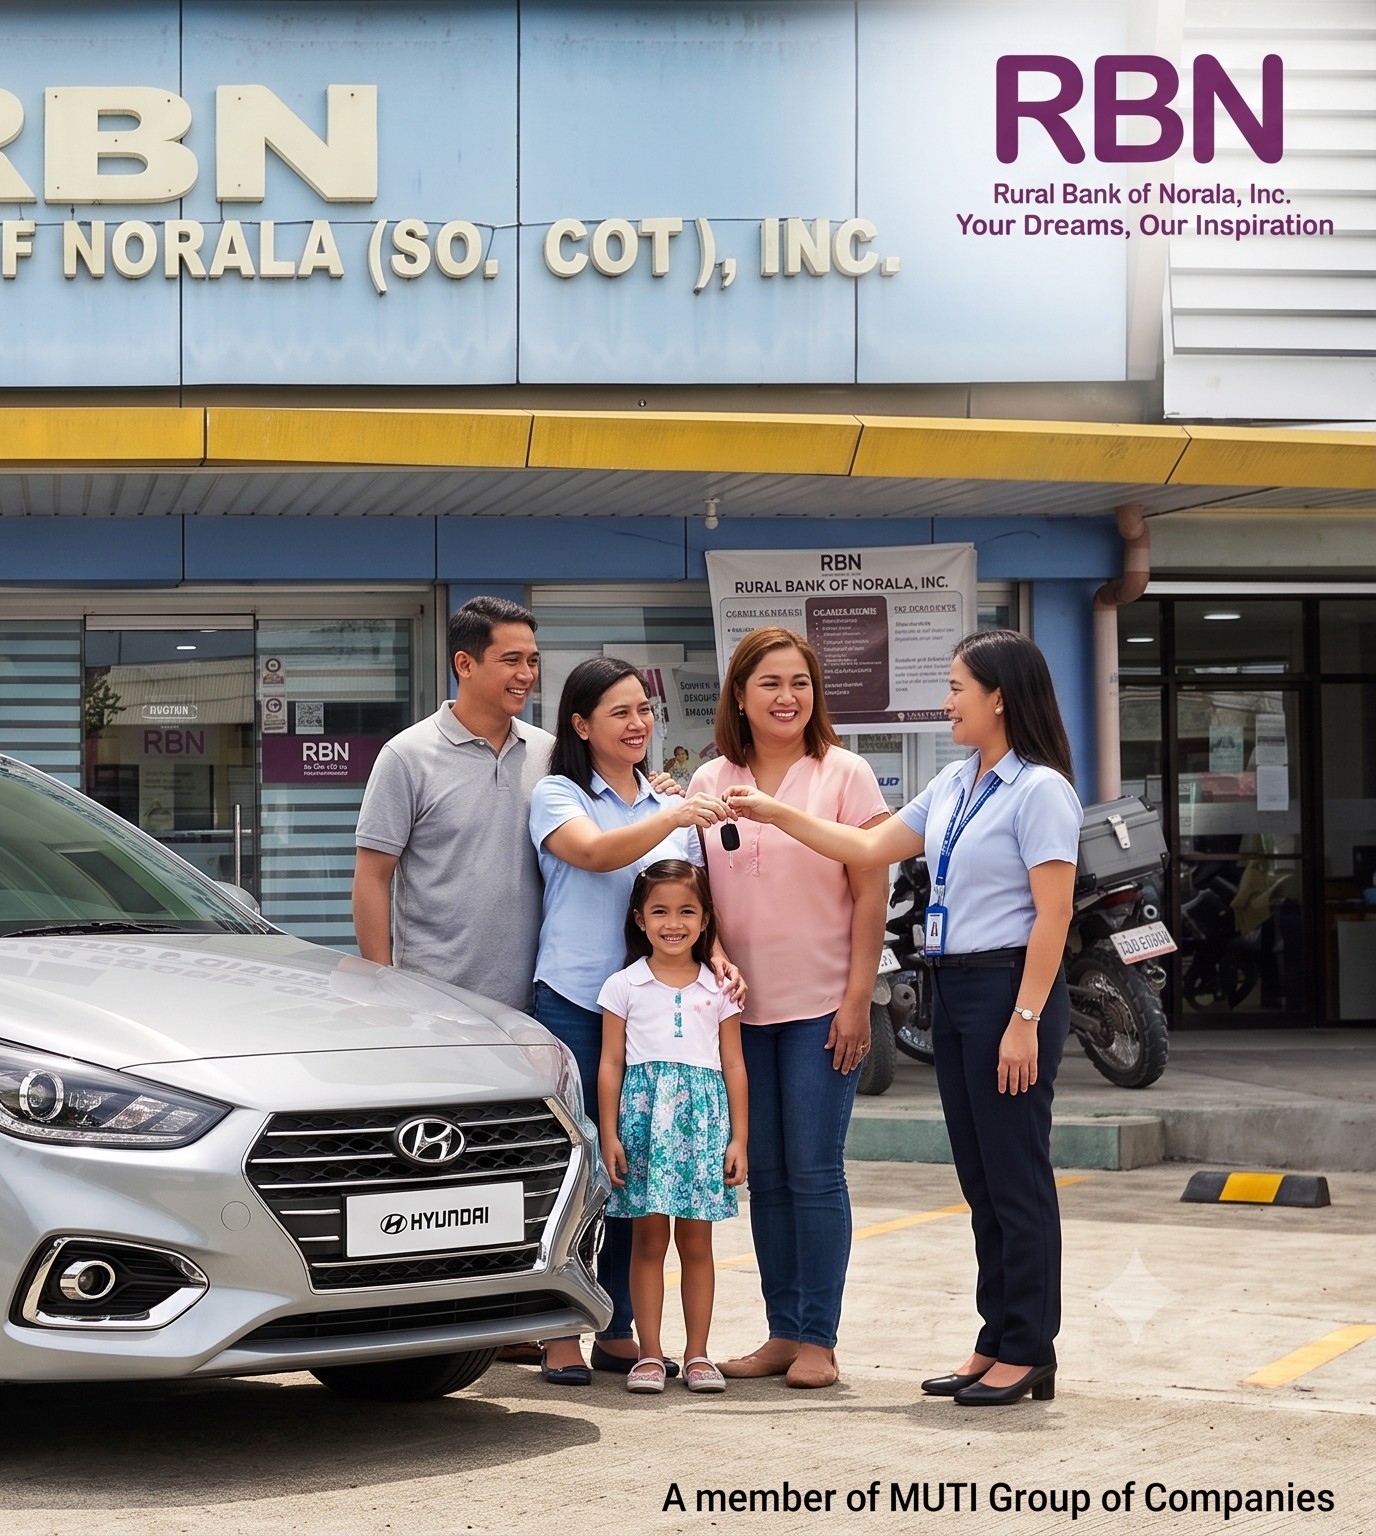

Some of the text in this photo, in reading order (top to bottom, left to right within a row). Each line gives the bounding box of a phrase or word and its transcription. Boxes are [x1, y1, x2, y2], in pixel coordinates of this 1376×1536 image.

[63, 219, 344, 280] NORALA
[368, 218, 499, 296] (SO.
[760, 218, 902, 279] INC.
[820, 554, 862, 571] RBN
[735, 576, 949, 594] RURAL BANK OF NORALA, INC.
[144, 730, 204, 755] RBN
[302, 742, 350, 761] RBN
[410, 1206, 489, 1231] HYUNDAI
